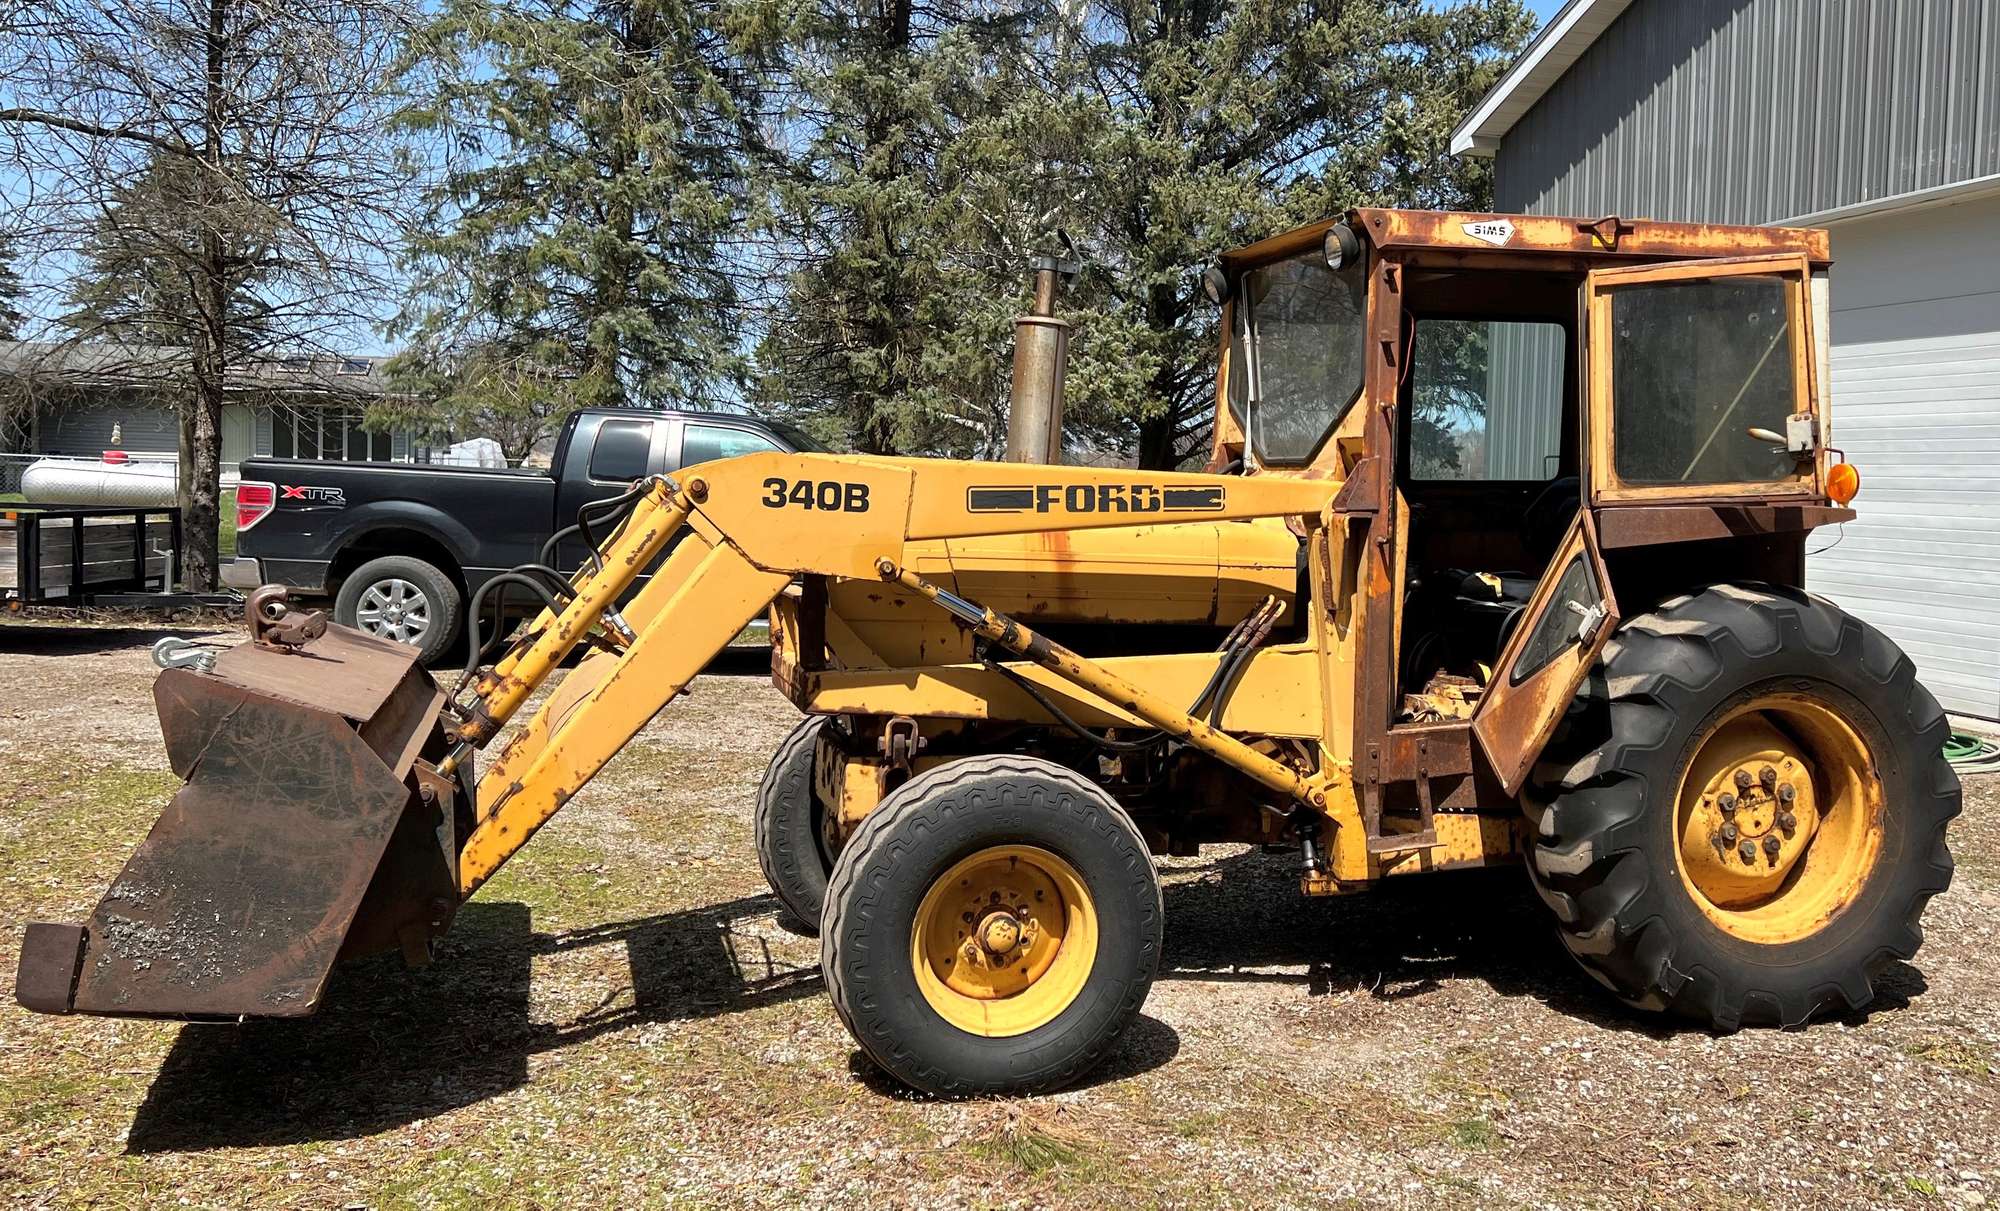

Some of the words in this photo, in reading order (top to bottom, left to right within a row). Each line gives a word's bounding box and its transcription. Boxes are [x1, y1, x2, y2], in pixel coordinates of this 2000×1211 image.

[280, 485, 346, 501] XTR
[762, 478, 870, 513] 340B
[1037, 485, 1161, 513] FORD
